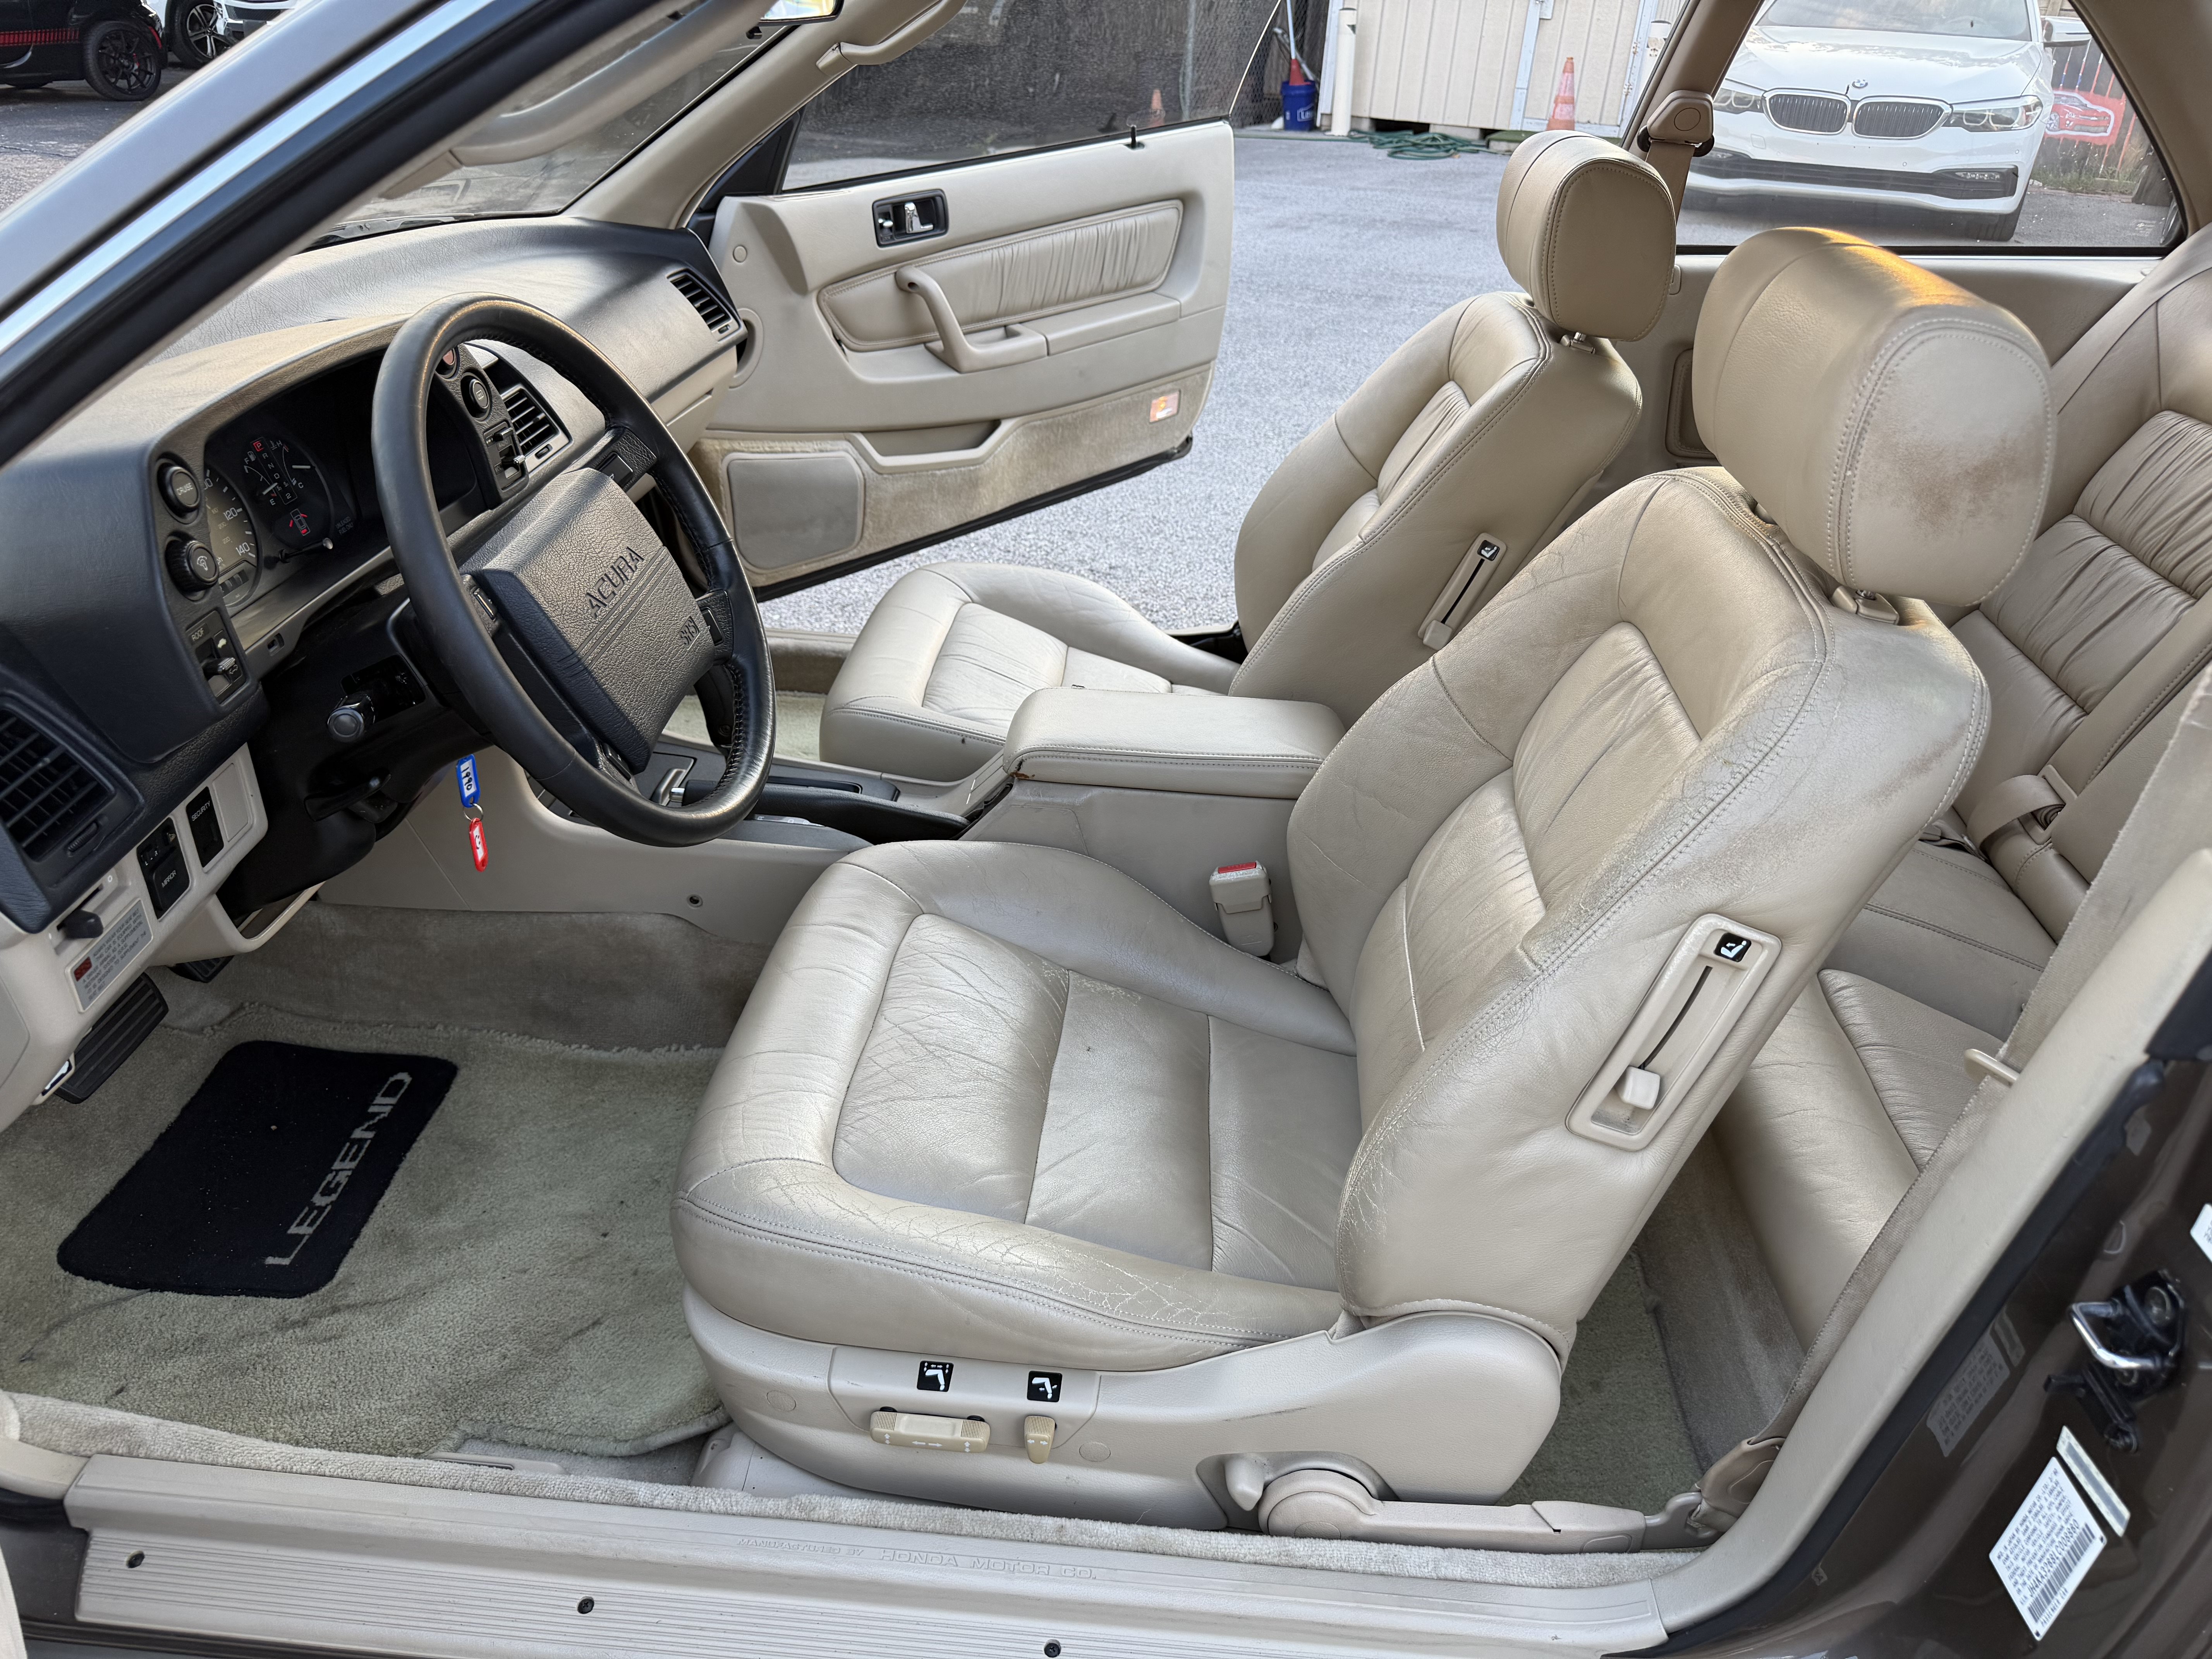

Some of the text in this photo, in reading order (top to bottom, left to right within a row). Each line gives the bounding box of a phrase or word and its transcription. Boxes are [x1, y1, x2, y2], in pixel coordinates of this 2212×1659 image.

[176, 483, 194, 495] CRUISE
[223, 507, 238, 521] 120
[222, 536, 231, 544] 220
[235, 542, 250, 556] 140
[585, 546, 645, 619] ACURA
[191, 627, 204, 641] ROOF
[680, 618, 698, 646] SRS
[462, 767, 472, 791] 1990
[191, 800, 211, 821] SECURITY
[161, 870, 177, 888] MIRROR
[265, 1072, 412, 1265] LEGEND
[737, 1539, 841, 1553] MANUFACTURED
[881, 1550, 958, 1566] HONDA
[970, 1558, 1050, 1575] MOTOR
[1061, 1566, 1097, 1580] CO.
